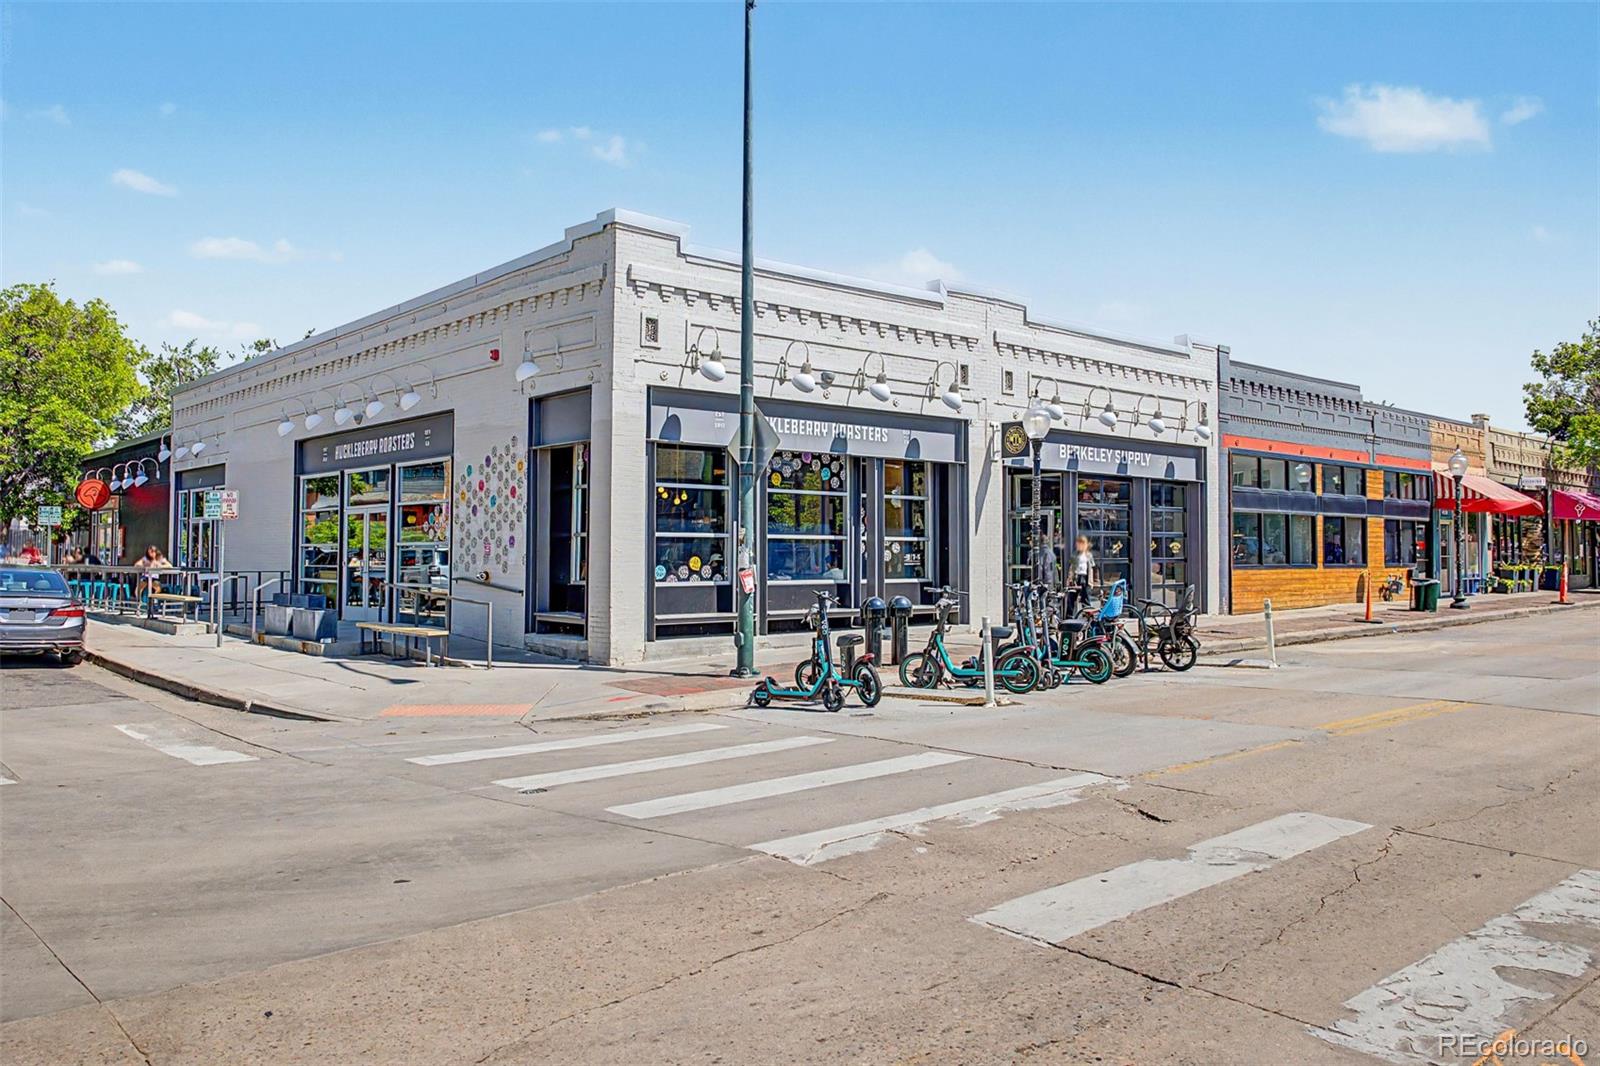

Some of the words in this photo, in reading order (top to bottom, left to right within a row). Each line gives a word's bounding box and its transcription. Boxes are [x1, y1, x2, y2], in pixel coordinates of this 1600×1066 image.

[764, 416, 828, 437] KLEBERRY
[832, 422, 888, 442] ROASTERS
[335, 439, 378, 460] HUCKLEBERRY
[379, 432, 415, 454] ROASTERS
[1059, 444, 1113, 463] BERKELEY
[1115, 449, 1152, 466] SUPPLY
[1062, 637, 1070, 656] veo
